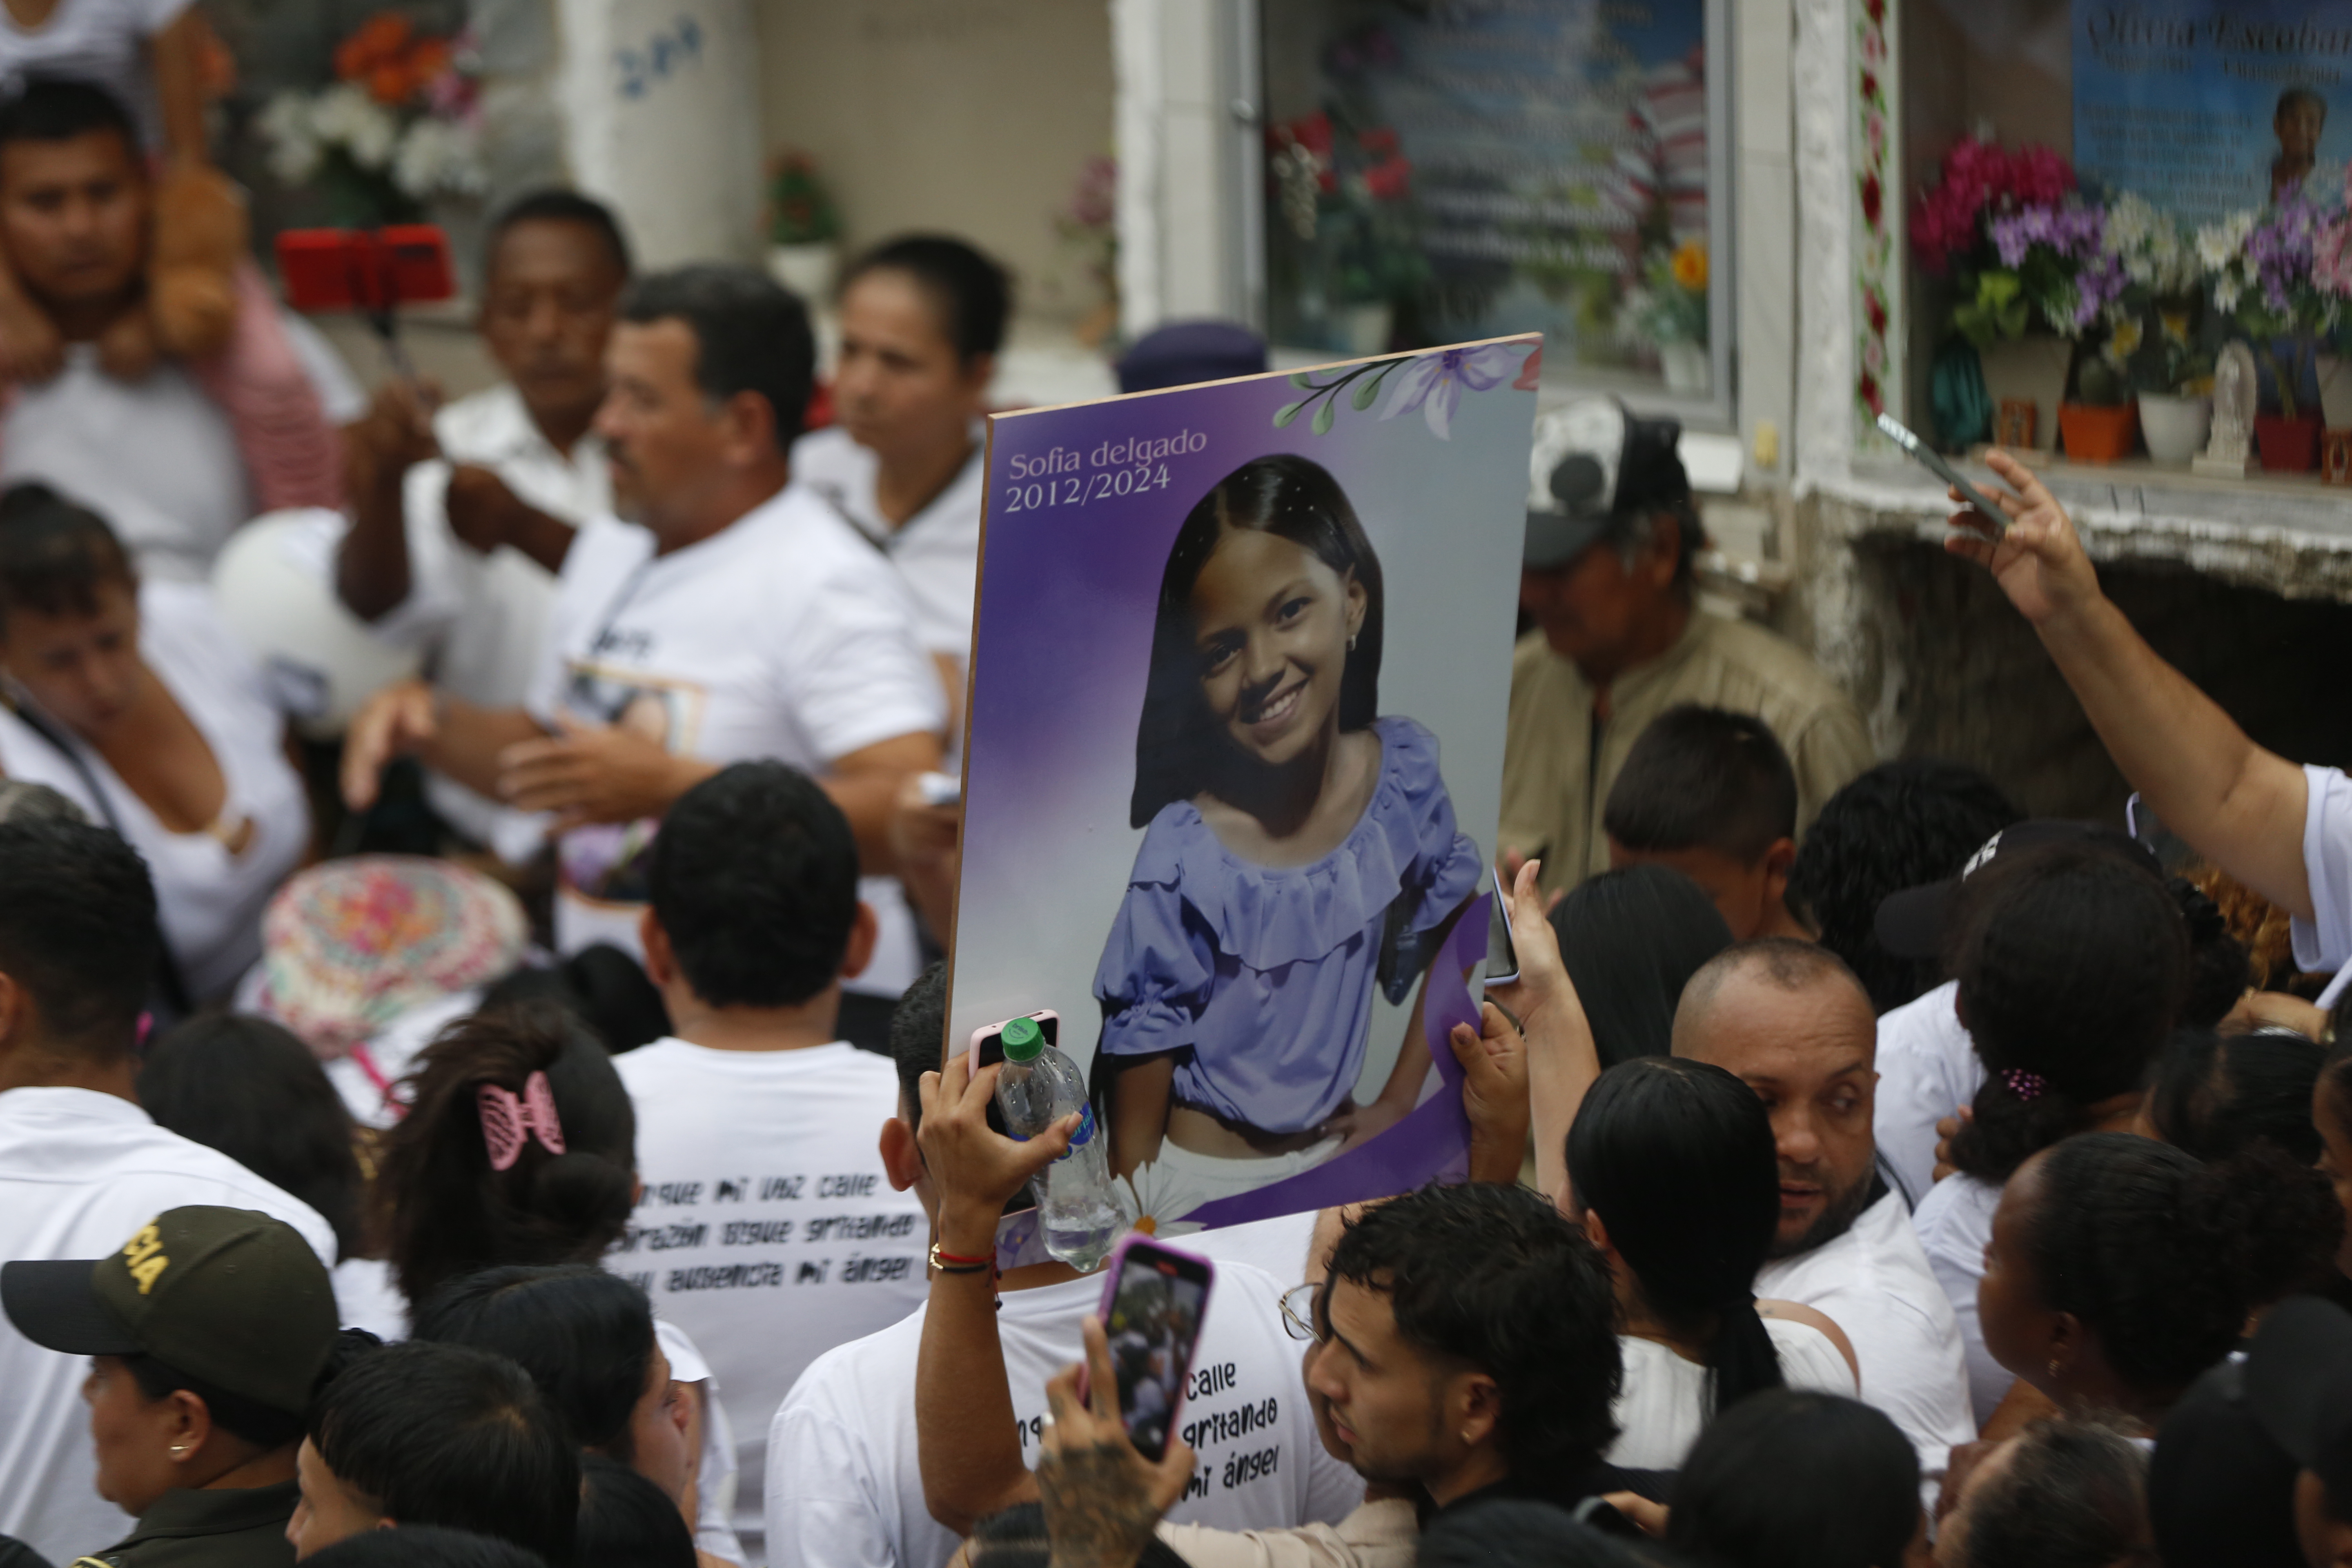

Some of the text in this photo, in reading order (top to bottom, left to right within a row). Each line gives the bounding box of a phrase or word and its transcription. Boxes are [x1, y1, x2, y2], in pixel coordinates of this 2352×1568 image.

[1009, 428, 1207, 480] Sofia delgado
[1004, 463, 1171, 513] 2012/2024
[815, 1173, 880, 1199] calle
[722, 1219, 794, 1247] sigue
[803, 1213, 916, 1243] gritando
[664, 1261, 784, 1293] ausencia
[840, 1251, 915, 1284] ángel
[1185, 1362, 1236, 1402] calle
[1182, 1397, 1278, 1449] gritando
[1181, 1445, 1280, 1502] mi ángel
